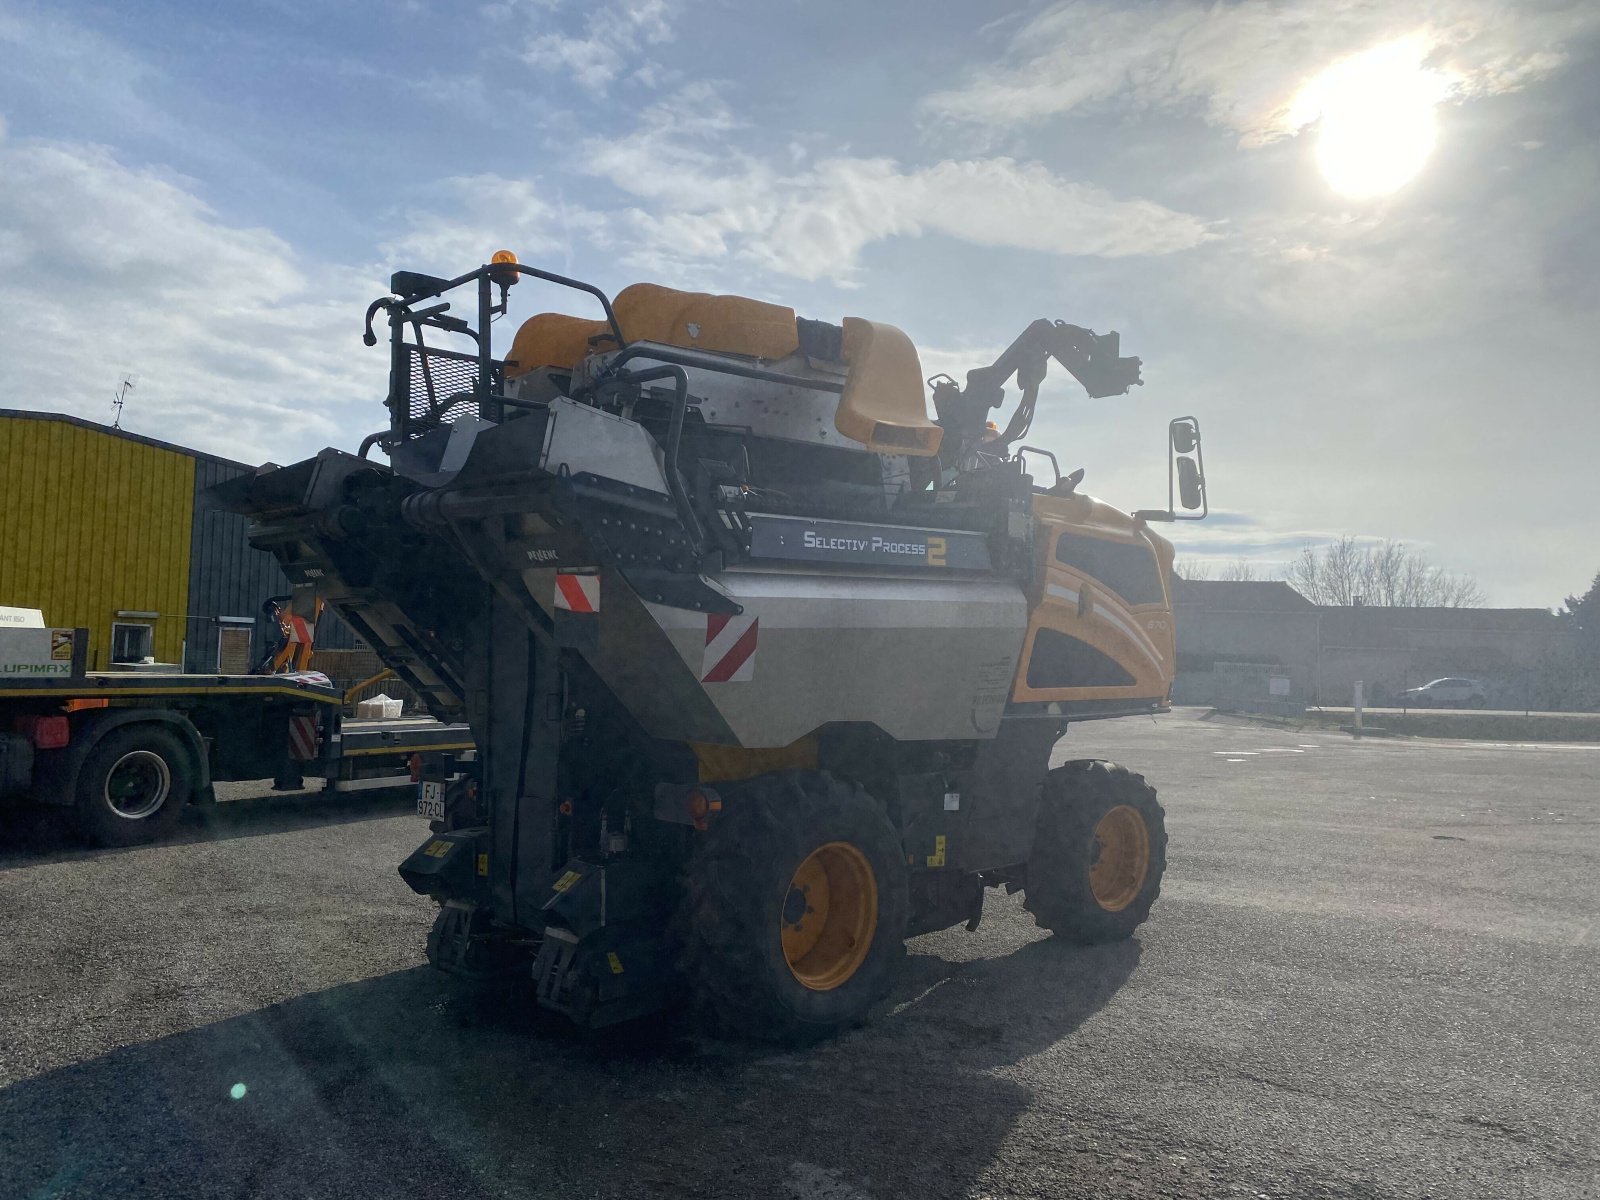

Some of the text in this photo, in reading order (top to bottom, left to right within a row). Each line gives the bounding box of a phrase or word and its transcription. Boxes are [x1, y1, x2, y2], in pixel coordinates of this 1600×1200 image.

[872, 537, 926, 555] PROCESS
[927, 536, 946, 566] 2
[0, 664, 70, 673] UPIMAX
